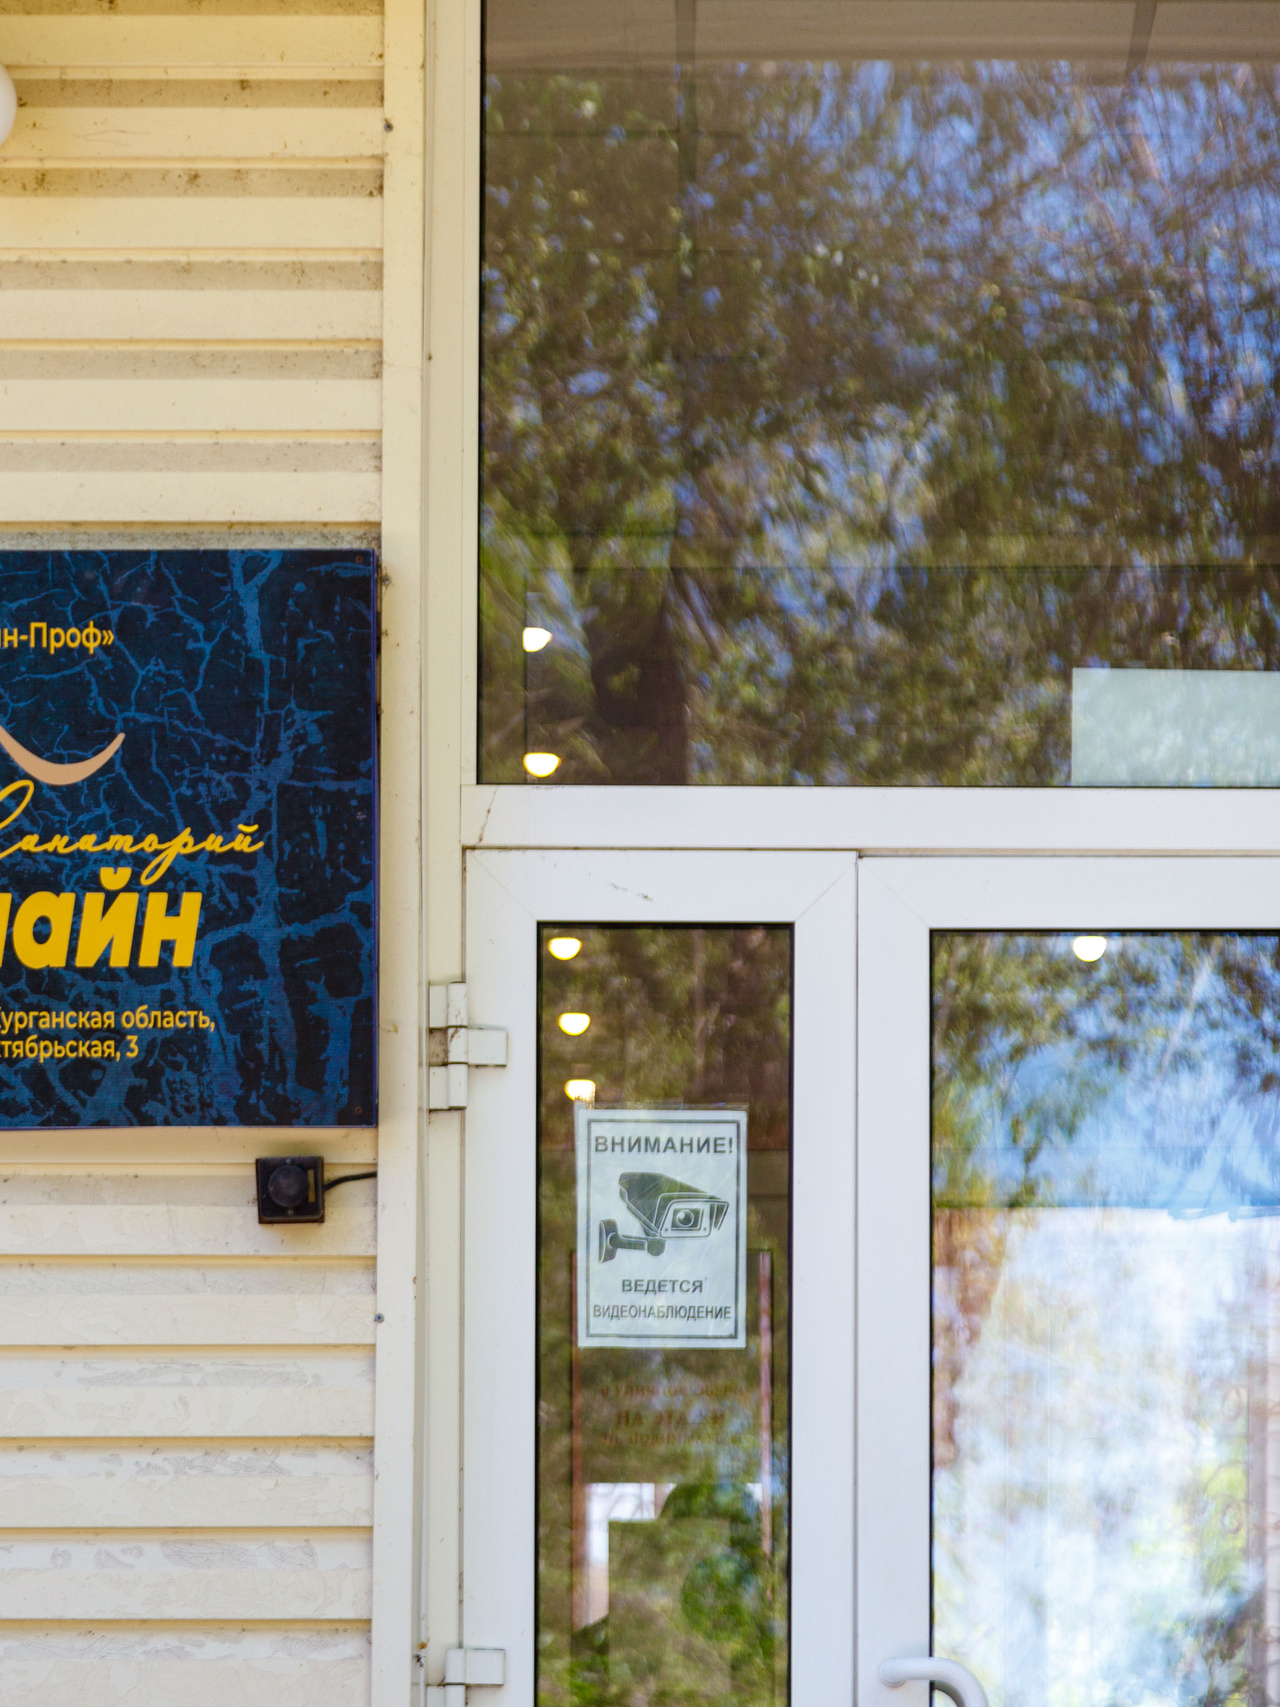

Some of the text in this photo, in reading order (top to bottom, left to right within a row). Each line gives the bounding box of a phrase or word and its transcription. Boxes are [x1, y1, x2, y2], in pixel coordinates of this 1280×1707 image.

[121, 1004, 216, 1033] область,
[125, 1035, 139, 1058] 3
[594, 1136, 733, 1154] ВНИМАНИЕ!
[622, 1279, 704, 1295] ВЕДЕТСЯ
[593, 1304, 732, 1321] ВИДЕОНАБЛЮДЕНИЕ
